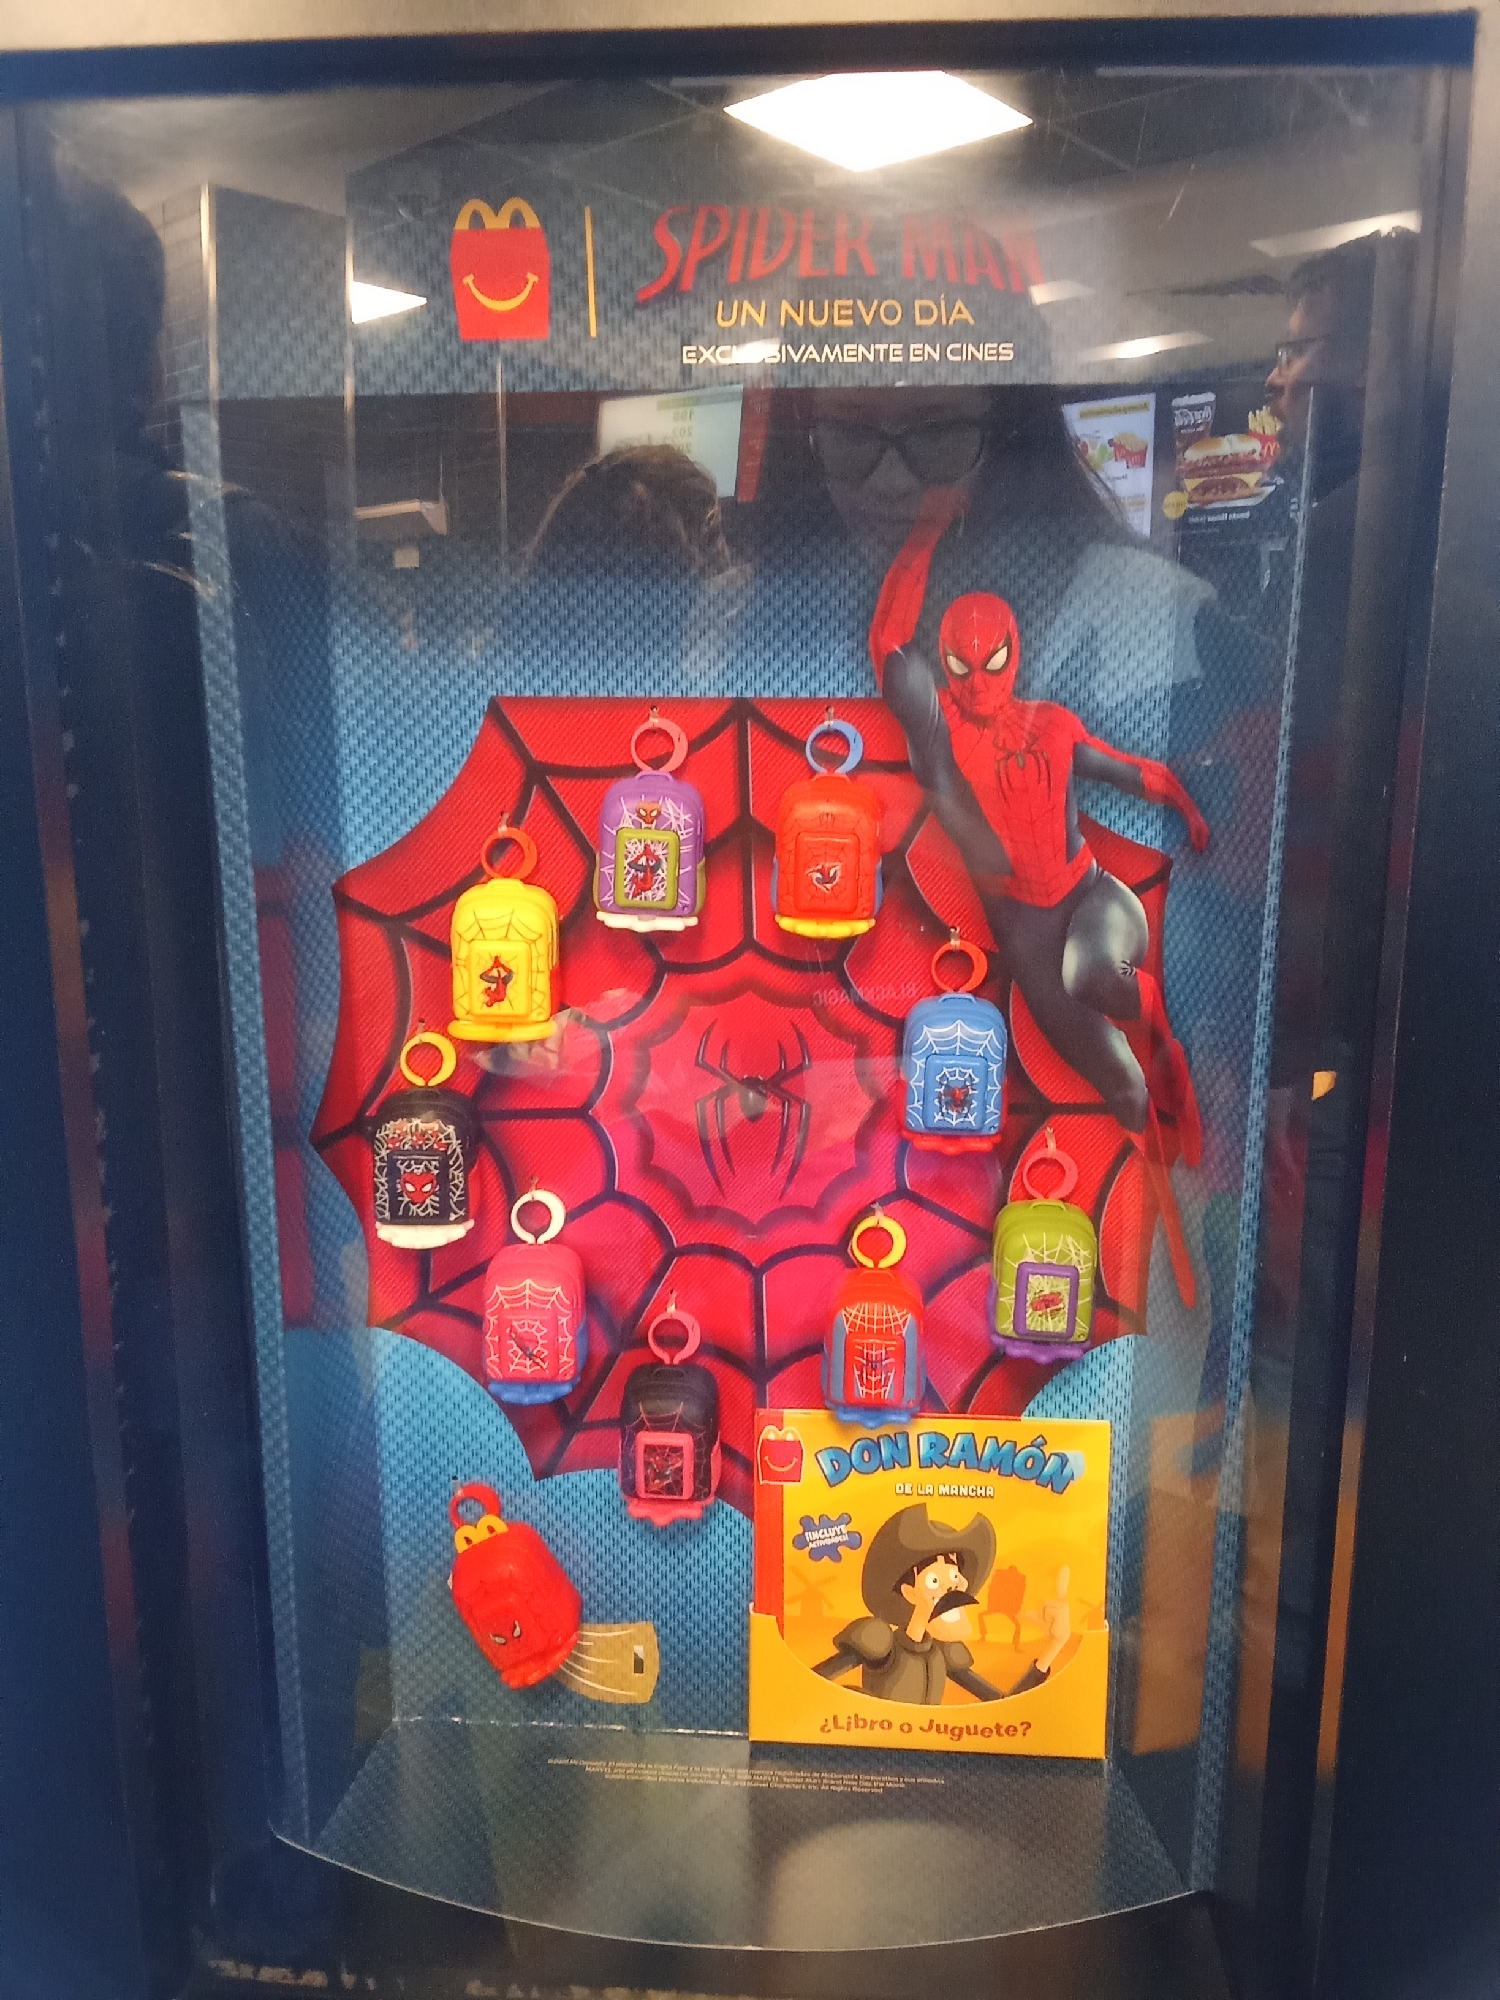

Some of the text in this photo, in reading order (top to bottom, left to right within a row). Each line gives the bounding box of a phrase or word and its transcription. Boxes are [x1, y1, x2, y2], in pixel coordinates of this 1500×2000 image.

[716, 293, 975, 327] UN NUEVO DÍA
[682, 342, 1014, 364] EXCLSIVAMENTE EN CINES
[814, 1431, 1083, 1495] DON RAMÓN
[895, 1482, 995, 1499] DE LA MANCHA
[819, 1713, 1032, 1742] ¿Libro o Juguete?
